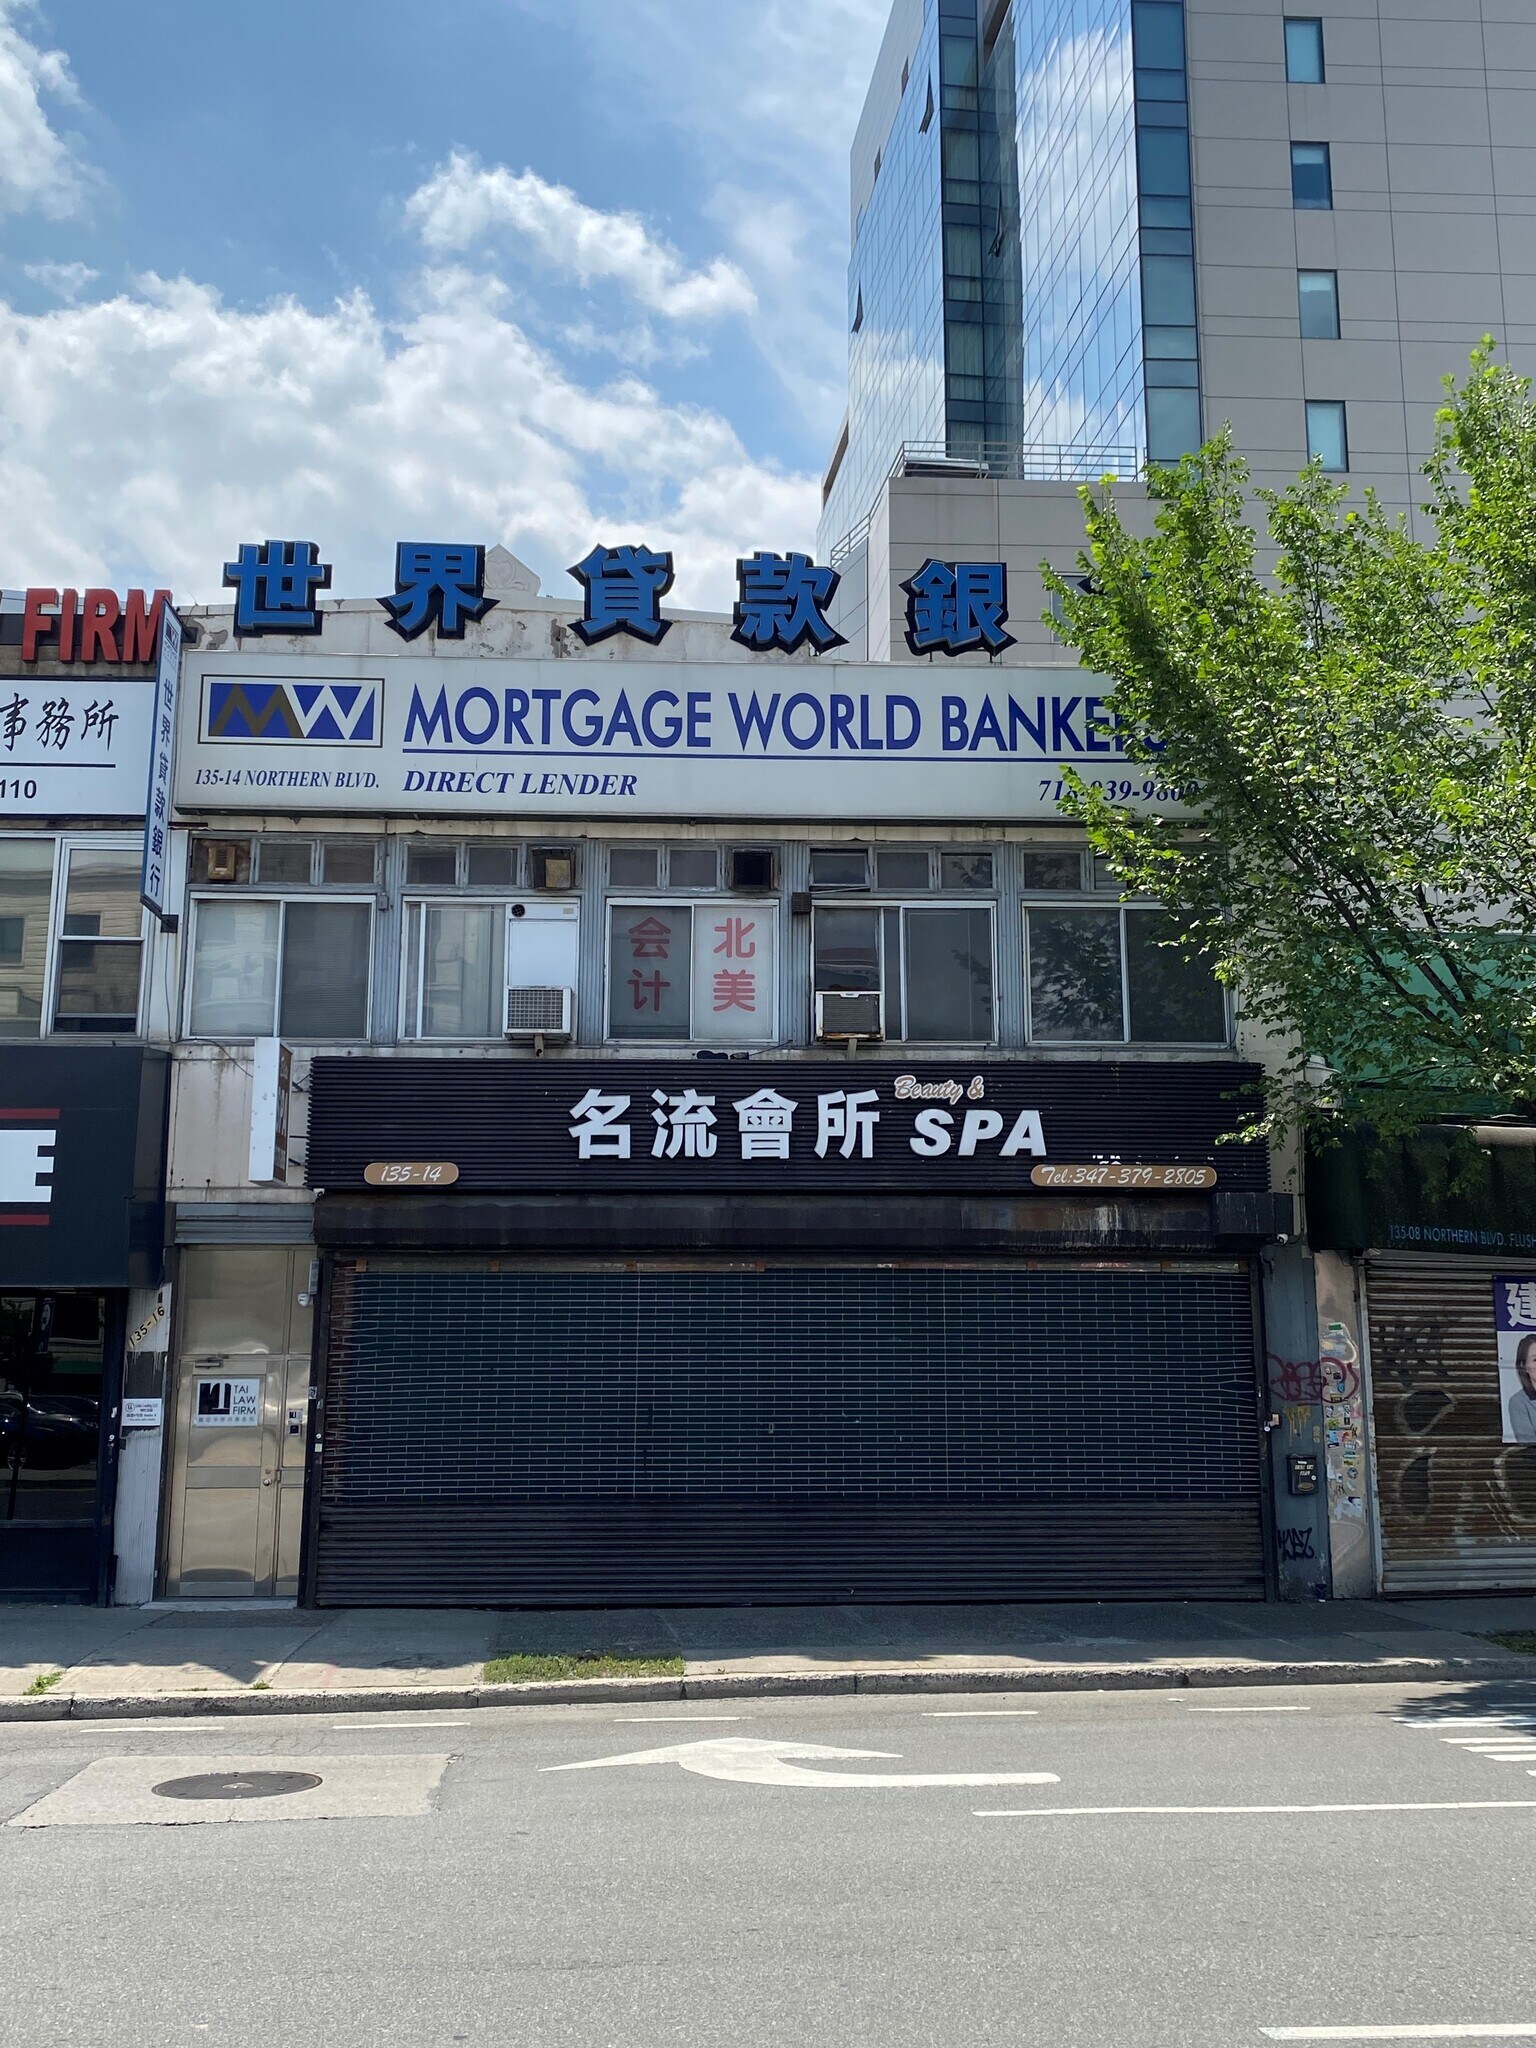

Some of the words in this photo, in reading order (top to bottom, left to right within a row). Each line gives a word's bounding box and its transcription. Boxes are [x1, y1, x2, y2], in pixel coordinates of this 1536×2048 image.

[223, 540, 1155, 654] 世界貸款銀
[21, 588, 173, 663] FIRM
[0, 692, 119, 751] 事務所
[403, 682, 712, 748] MORTGAGE
[727, 690, 922, 752] WORLD
[941, 693, 1168, 755] BANKE
[195, 769, 241, 785] 135-14
[243, 769, 332, 788] NORTHERN
[334, 770, 379, 789] BLVD.
[402, 770, 514, 794] DIRECT
[518, 772, 638, 796] LENDER
[627, 916, 672, 1012] 会计
[713, 917, 756, 1012] 北美
[894, 1075, 963, 1105] Beauty
[967, 1075, 985, 1100] &
[568, 1088, 880, 1160] 名流會所
[909, 1108, 1047, 1157] SPA
[380, 1165, 441, 1182] 135-14
[1041, 1166, 1206, 1185] Tel:347-379-2805
[1390, 1224, 1421, 1241] 135-08
[1423, 1227, 1478, 1245] NORTHERN
[129, 1306, 165, 1347] 135-16
[233, 1396, 256, 1405] LAW
[234, 1385, 249, 1393] TAI
[233, 1406, 257, 1415] FIRM
